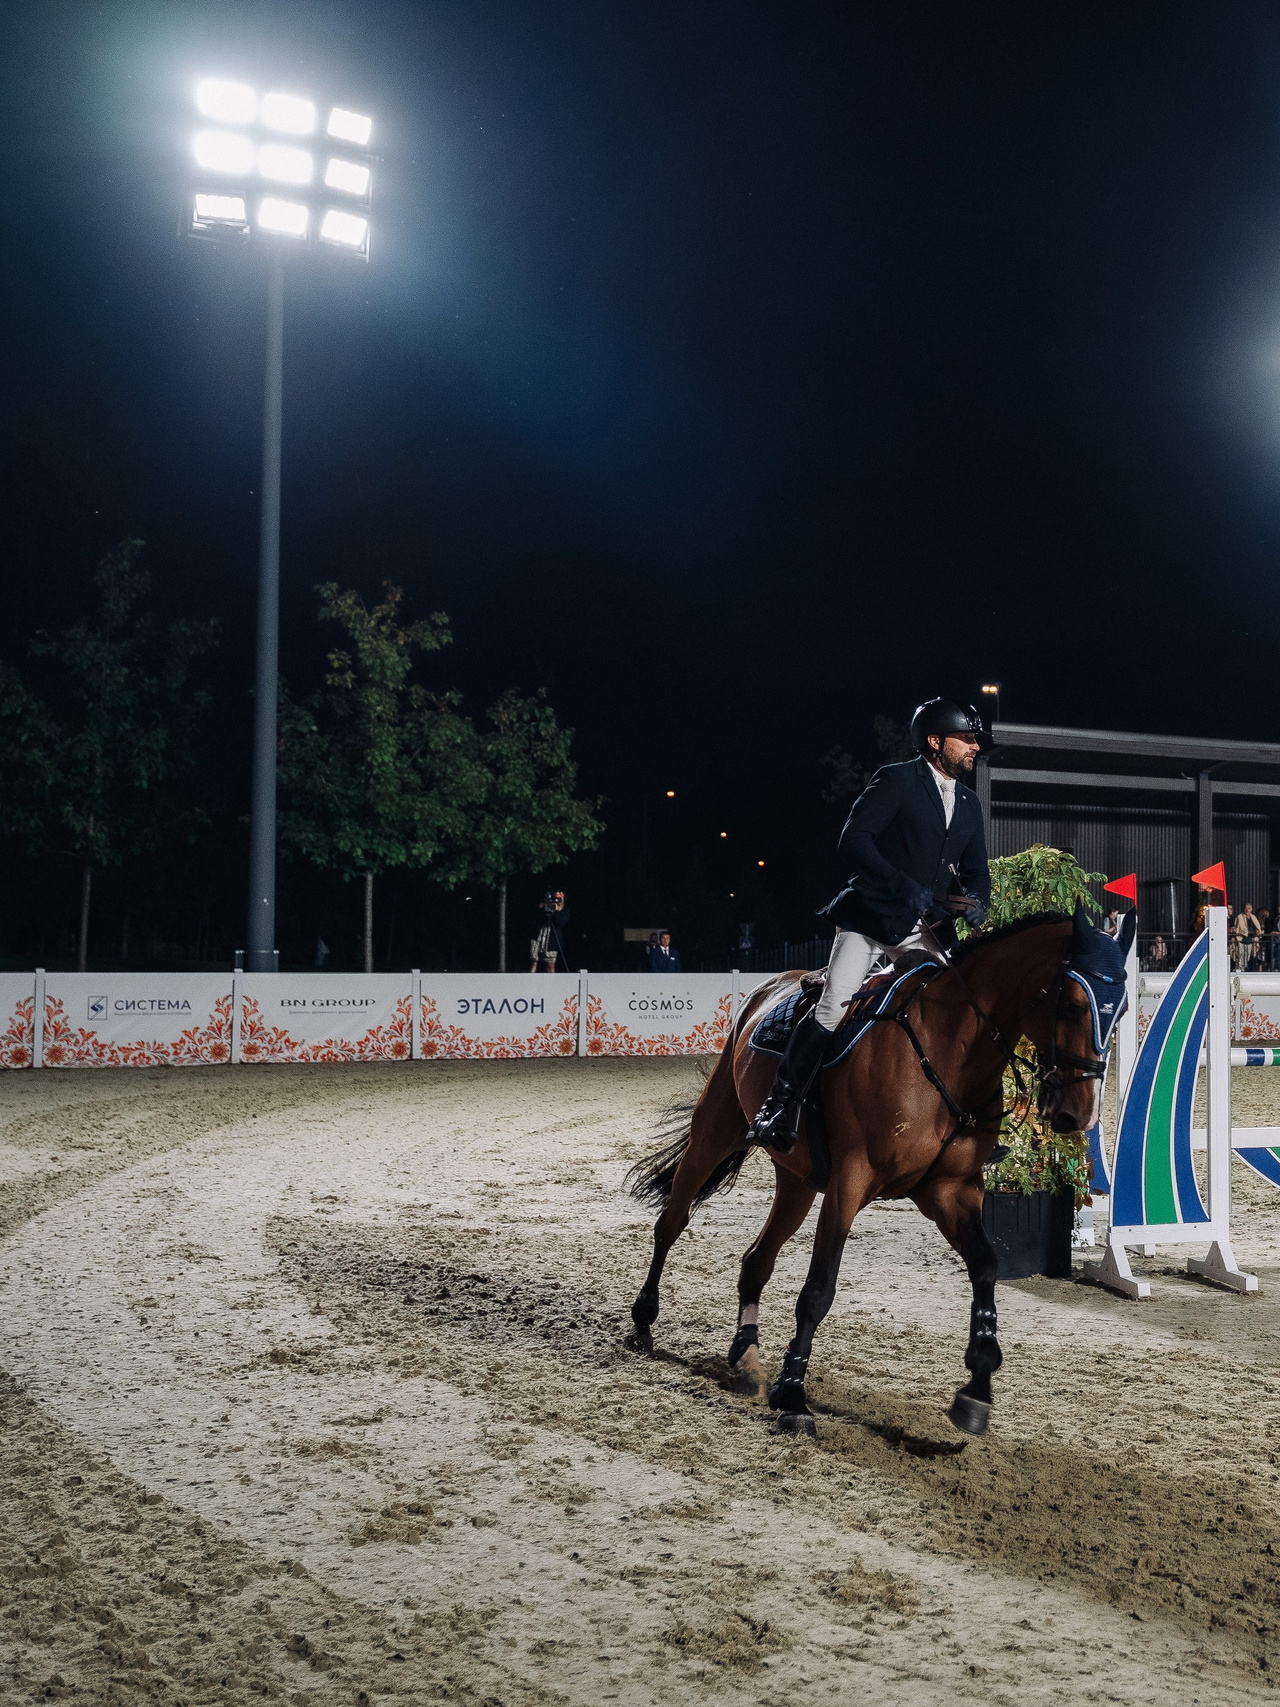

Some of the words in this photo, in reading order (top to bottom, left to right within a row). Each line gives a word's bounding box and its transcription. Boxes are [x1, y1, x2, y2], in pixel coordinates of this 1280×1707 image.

[114, 1000, 191, 1010] СИСТЕМА
[280, 999, 306, 1007] BN
[311, 999, 376, 1007] GROUP
[457, 998, 545, 1014] ЭТАЛОН
[628, 999, 693, 1011] COSMOS
